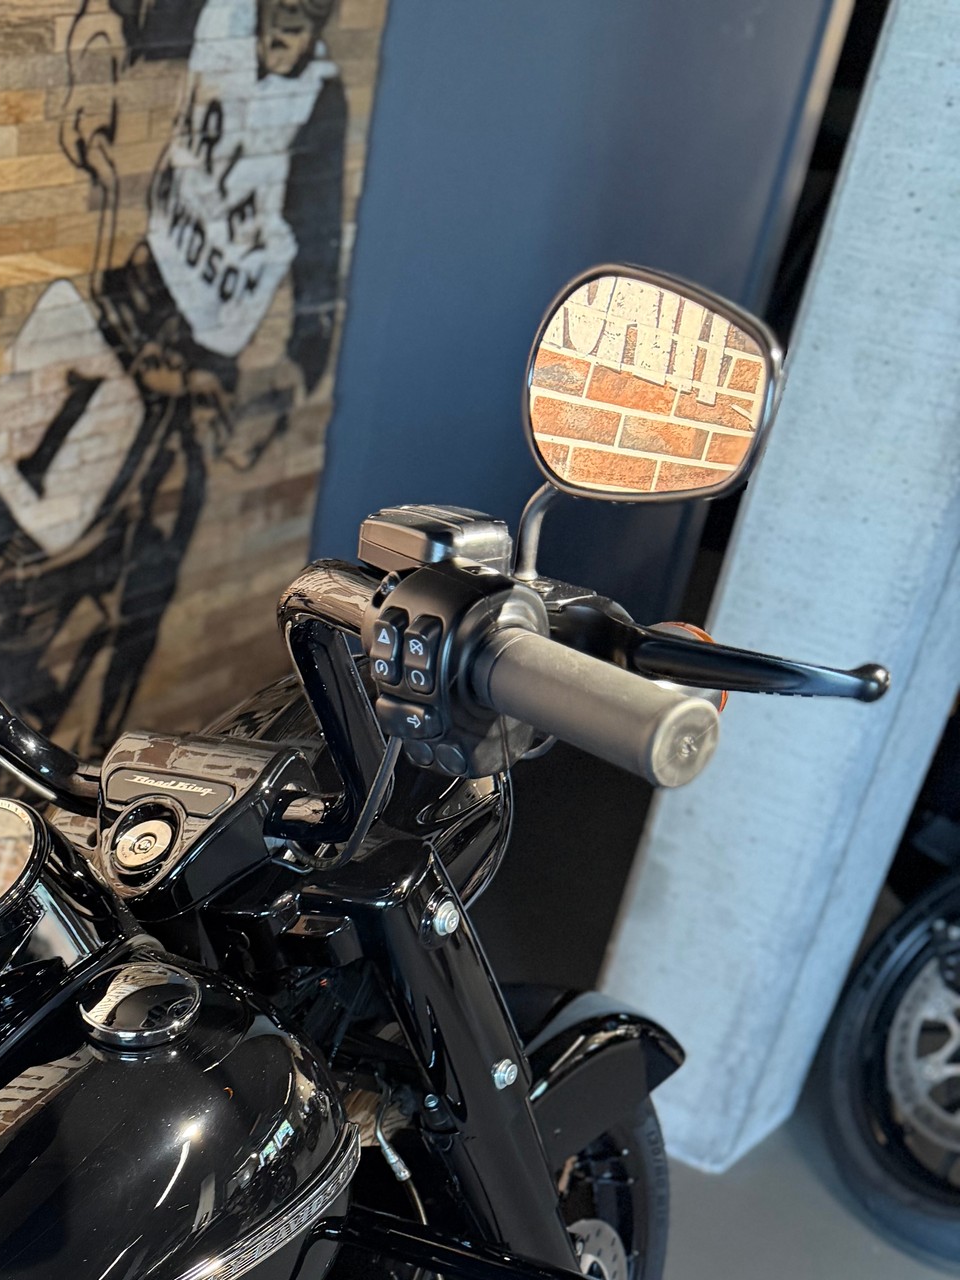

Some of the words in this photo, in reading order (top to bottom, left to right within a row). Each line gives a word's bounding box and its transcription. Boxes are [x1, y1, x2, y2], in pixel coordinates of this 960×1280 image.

[174, 77, 266, 259] ARLEY
[125, 774, 177, 790] Road
[174, 781, 217, 797] King
